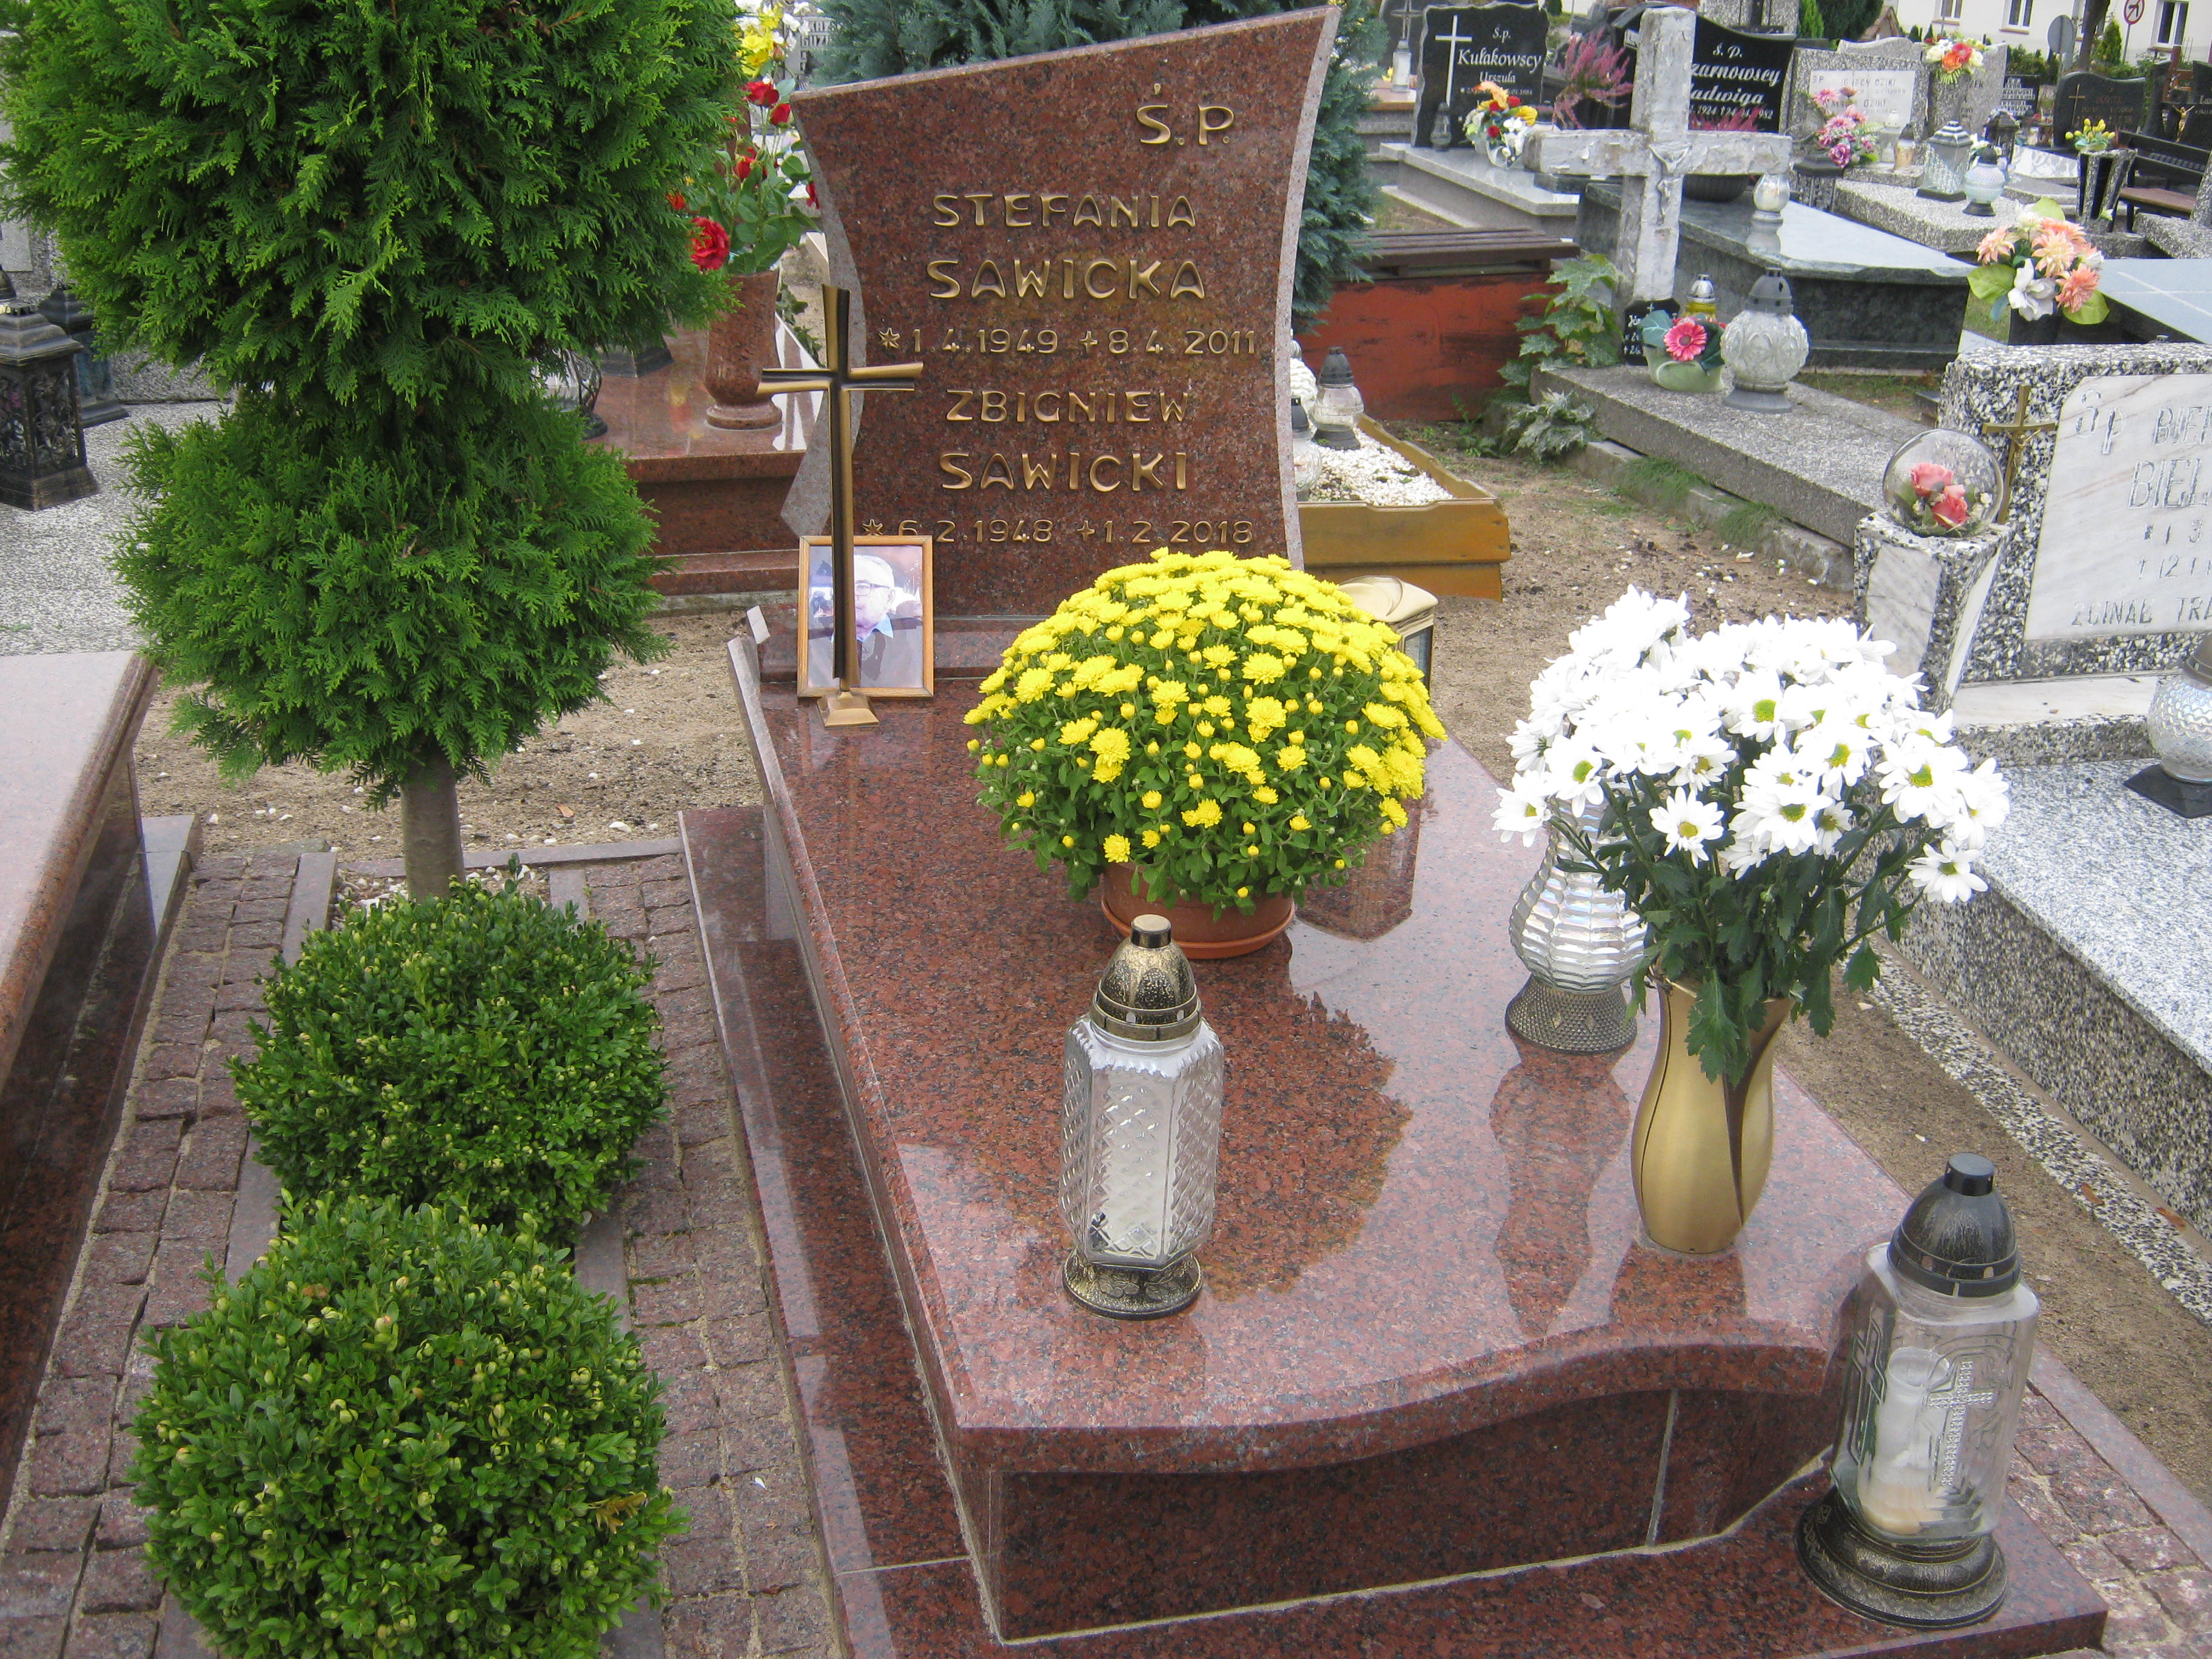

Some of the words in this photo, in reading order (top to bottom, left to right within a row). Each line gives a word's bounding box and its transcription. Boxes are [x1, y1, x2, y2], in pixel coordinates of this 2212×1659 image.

[1457, 47, 1542, 73] Kułakowscy
[1692, 63, 1781, 87] zarnowscy
[1690, 82, 1765, 107] adwiga
[932, 193, 1196, 227] STEFANIA
[925, 258, 1206, 300] SAWICKA
[945, 389, 1189, 423] ZBIGNIEW
[939, 451, 1187, 491] SAWICKI
[2127, 458, 2212, 509] BIEL
